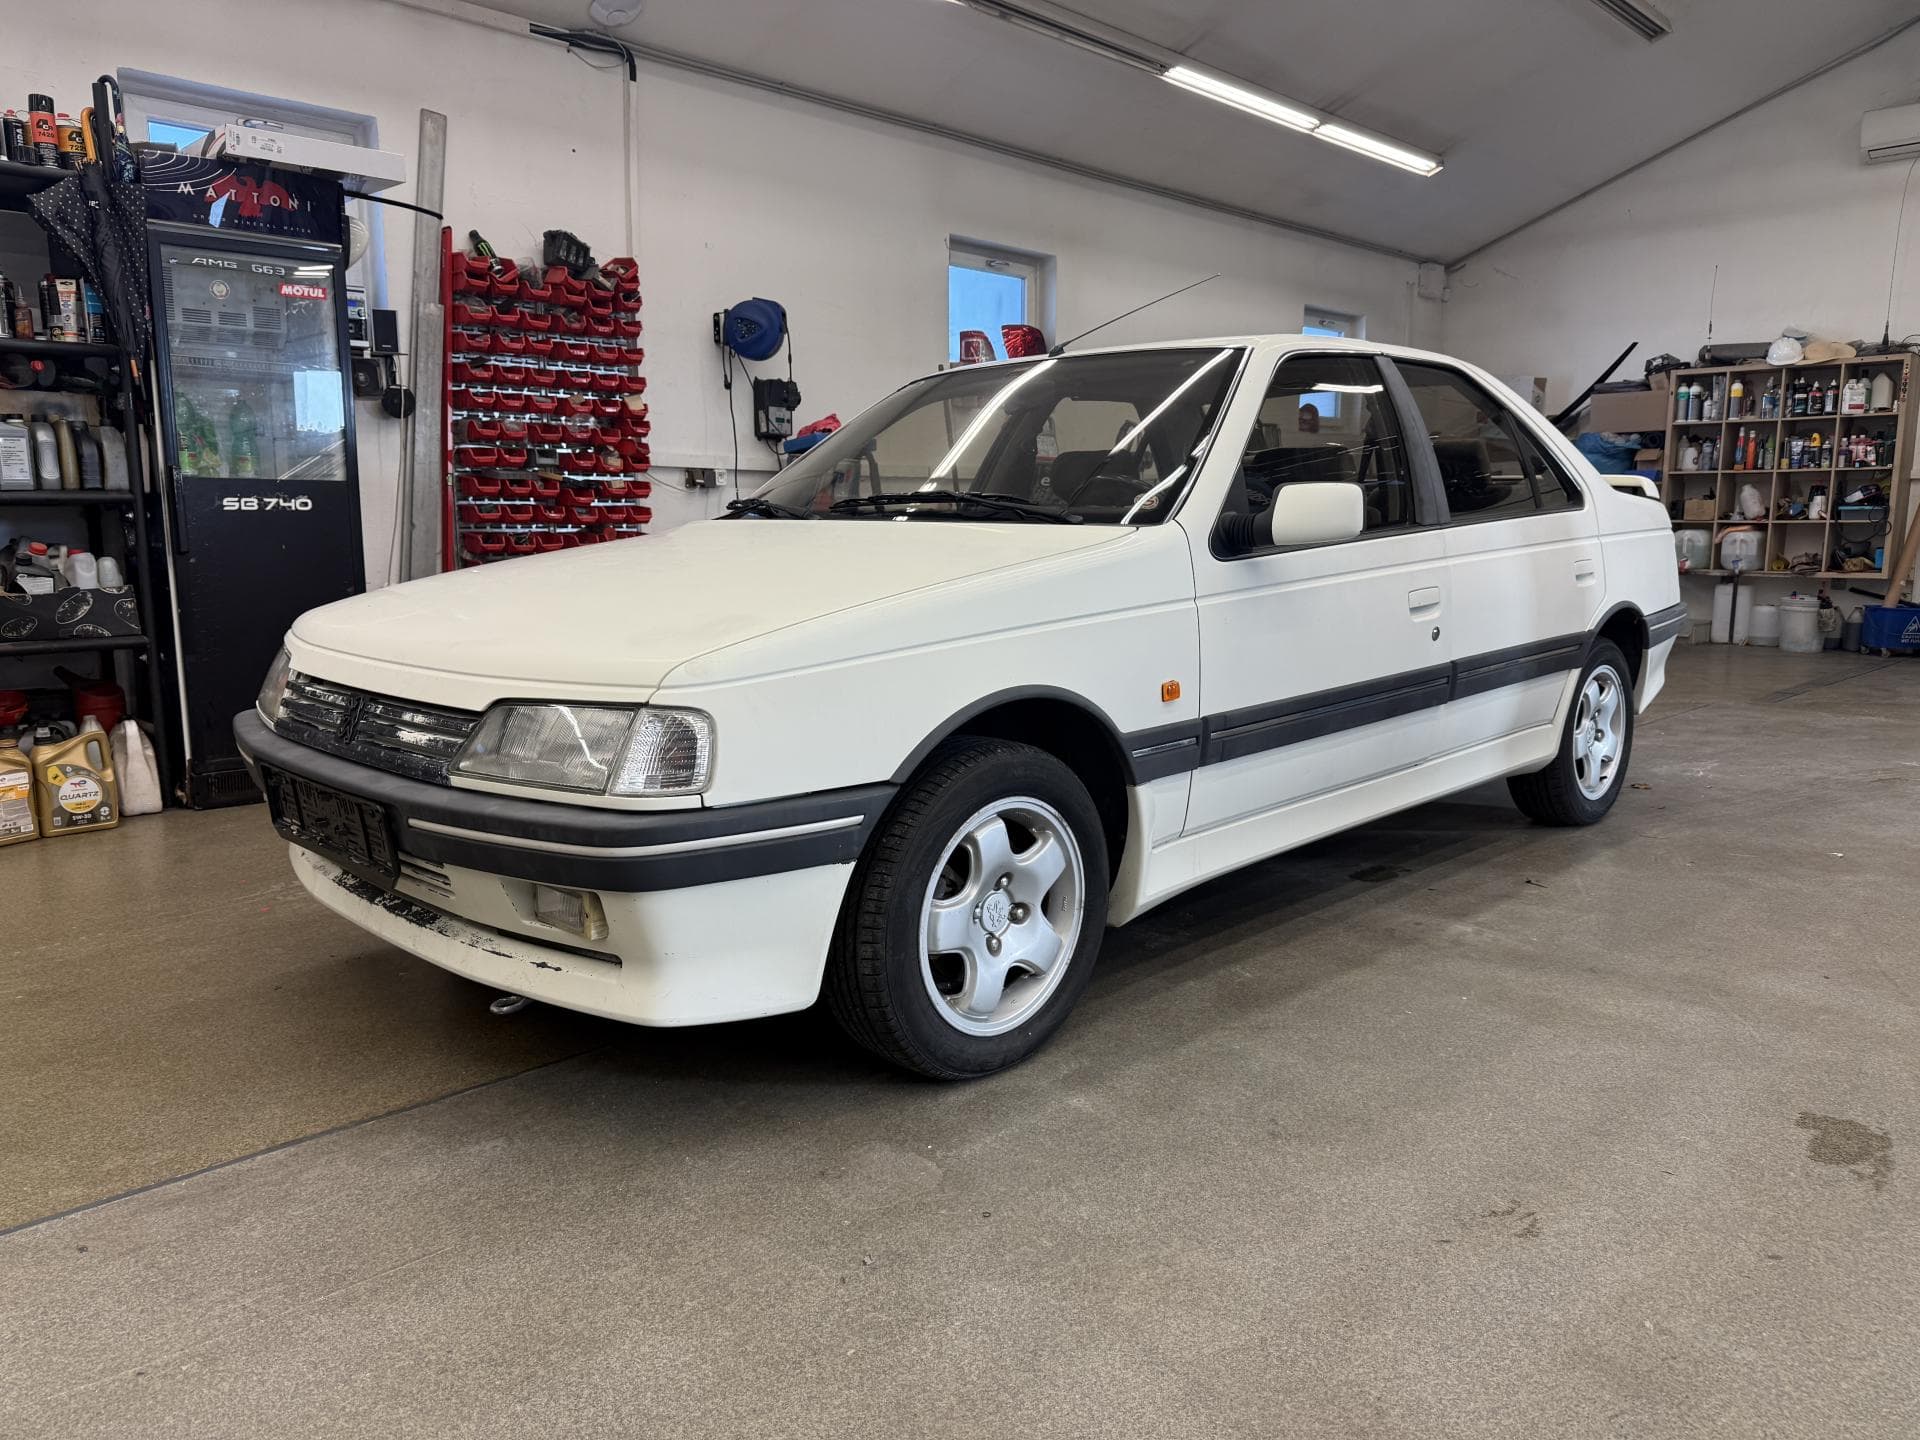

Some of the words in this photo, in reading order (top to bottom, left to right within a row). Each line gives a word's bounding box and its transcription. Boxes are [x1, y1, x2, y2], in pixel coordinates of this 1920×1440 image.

[177, 181, 311, 212] MATTONI
[191, 257, 238, 269] AMG
[251, 264, 286, 276] G63
[280, 285, 325, 298] MOTUL
[222, 497, 259, 511] SB
[263, 497, 313, 511] 740
[60, 790, 99, 801] QUARTZ
